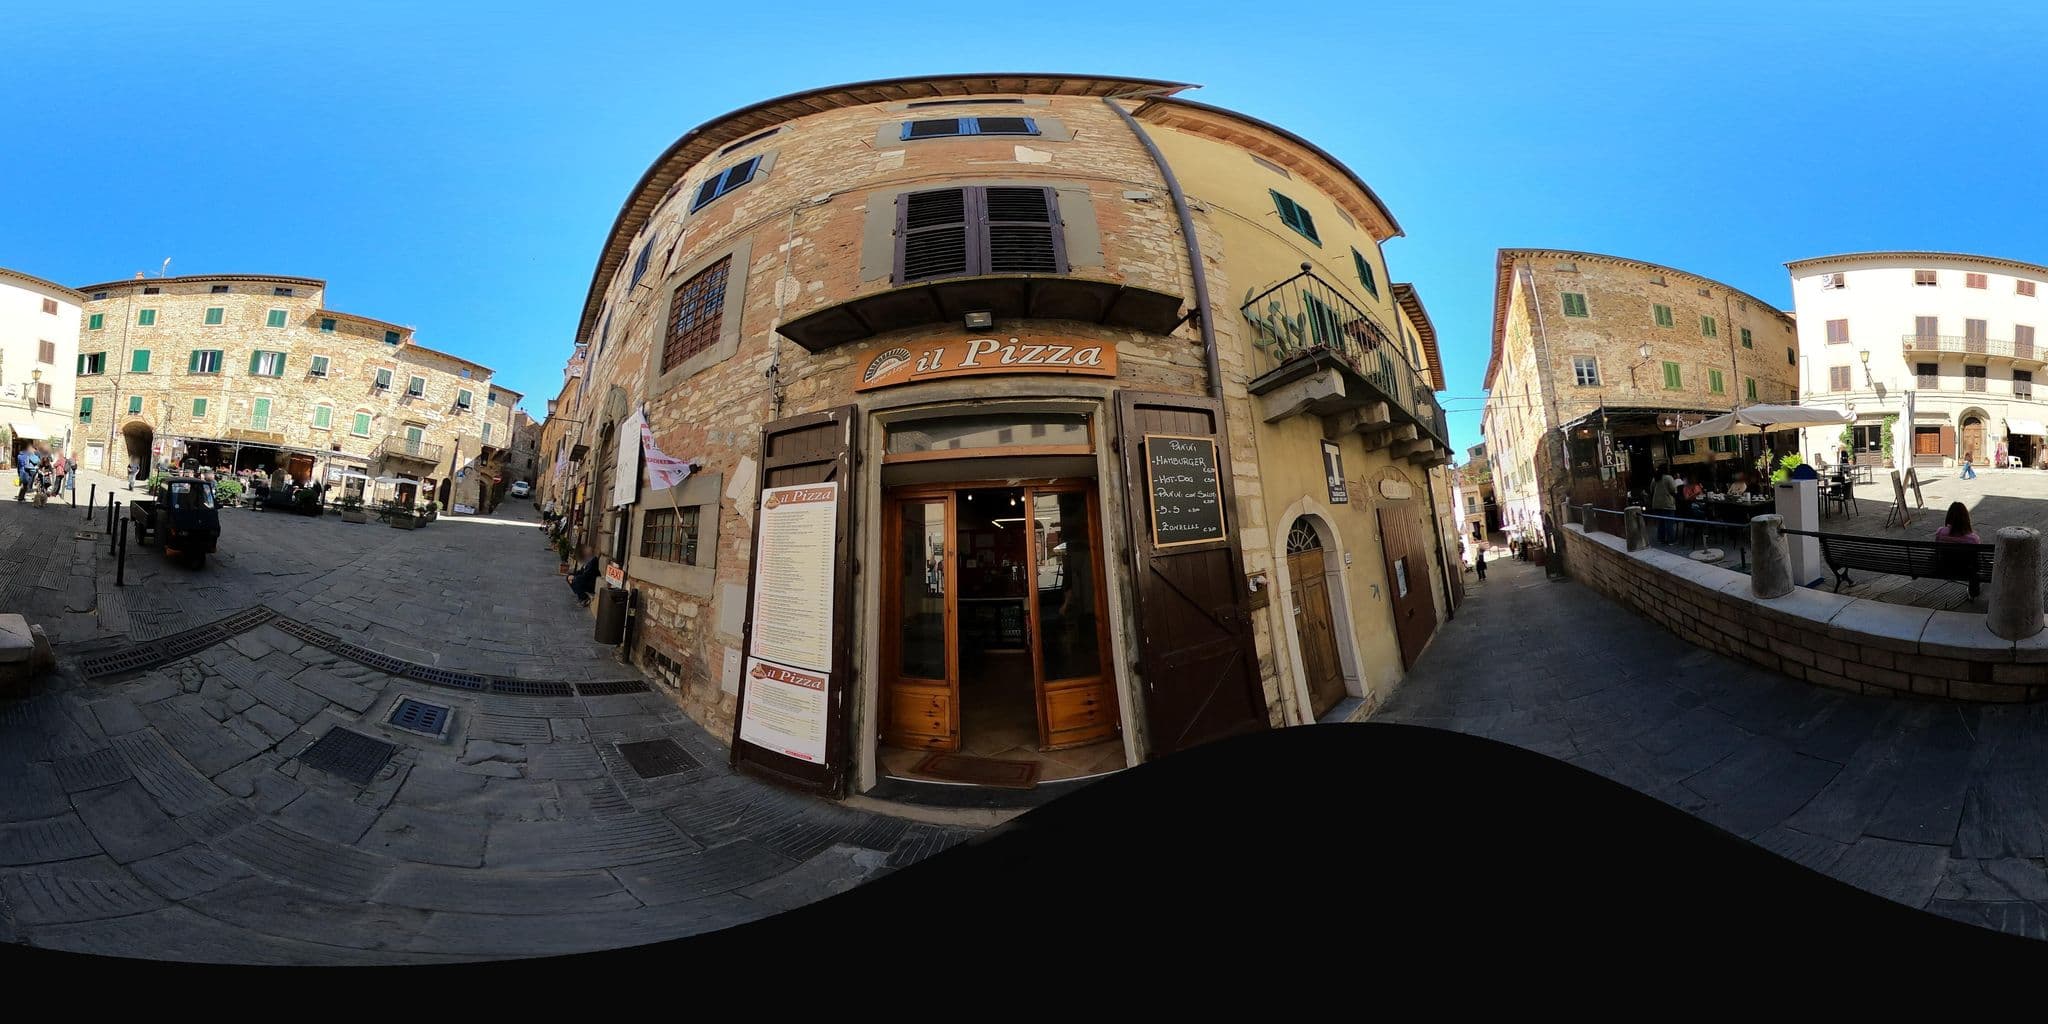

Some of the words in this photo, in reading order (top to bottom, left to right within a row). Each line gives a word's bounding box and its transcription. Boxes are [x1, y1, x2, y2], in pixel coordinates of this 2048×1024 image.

[915, 348, 945, 372] il
[958, 337, 1103, 367] Pizza
[1603, 435, 1613, 465] BAR
[780, 494, 788, 503] il
[792, 489, 832, 502] Pizza
[608, 567, 621, 580] TAXI
[767, 669, 775, 678] il
[780, 670, 821, 689] Pizza
